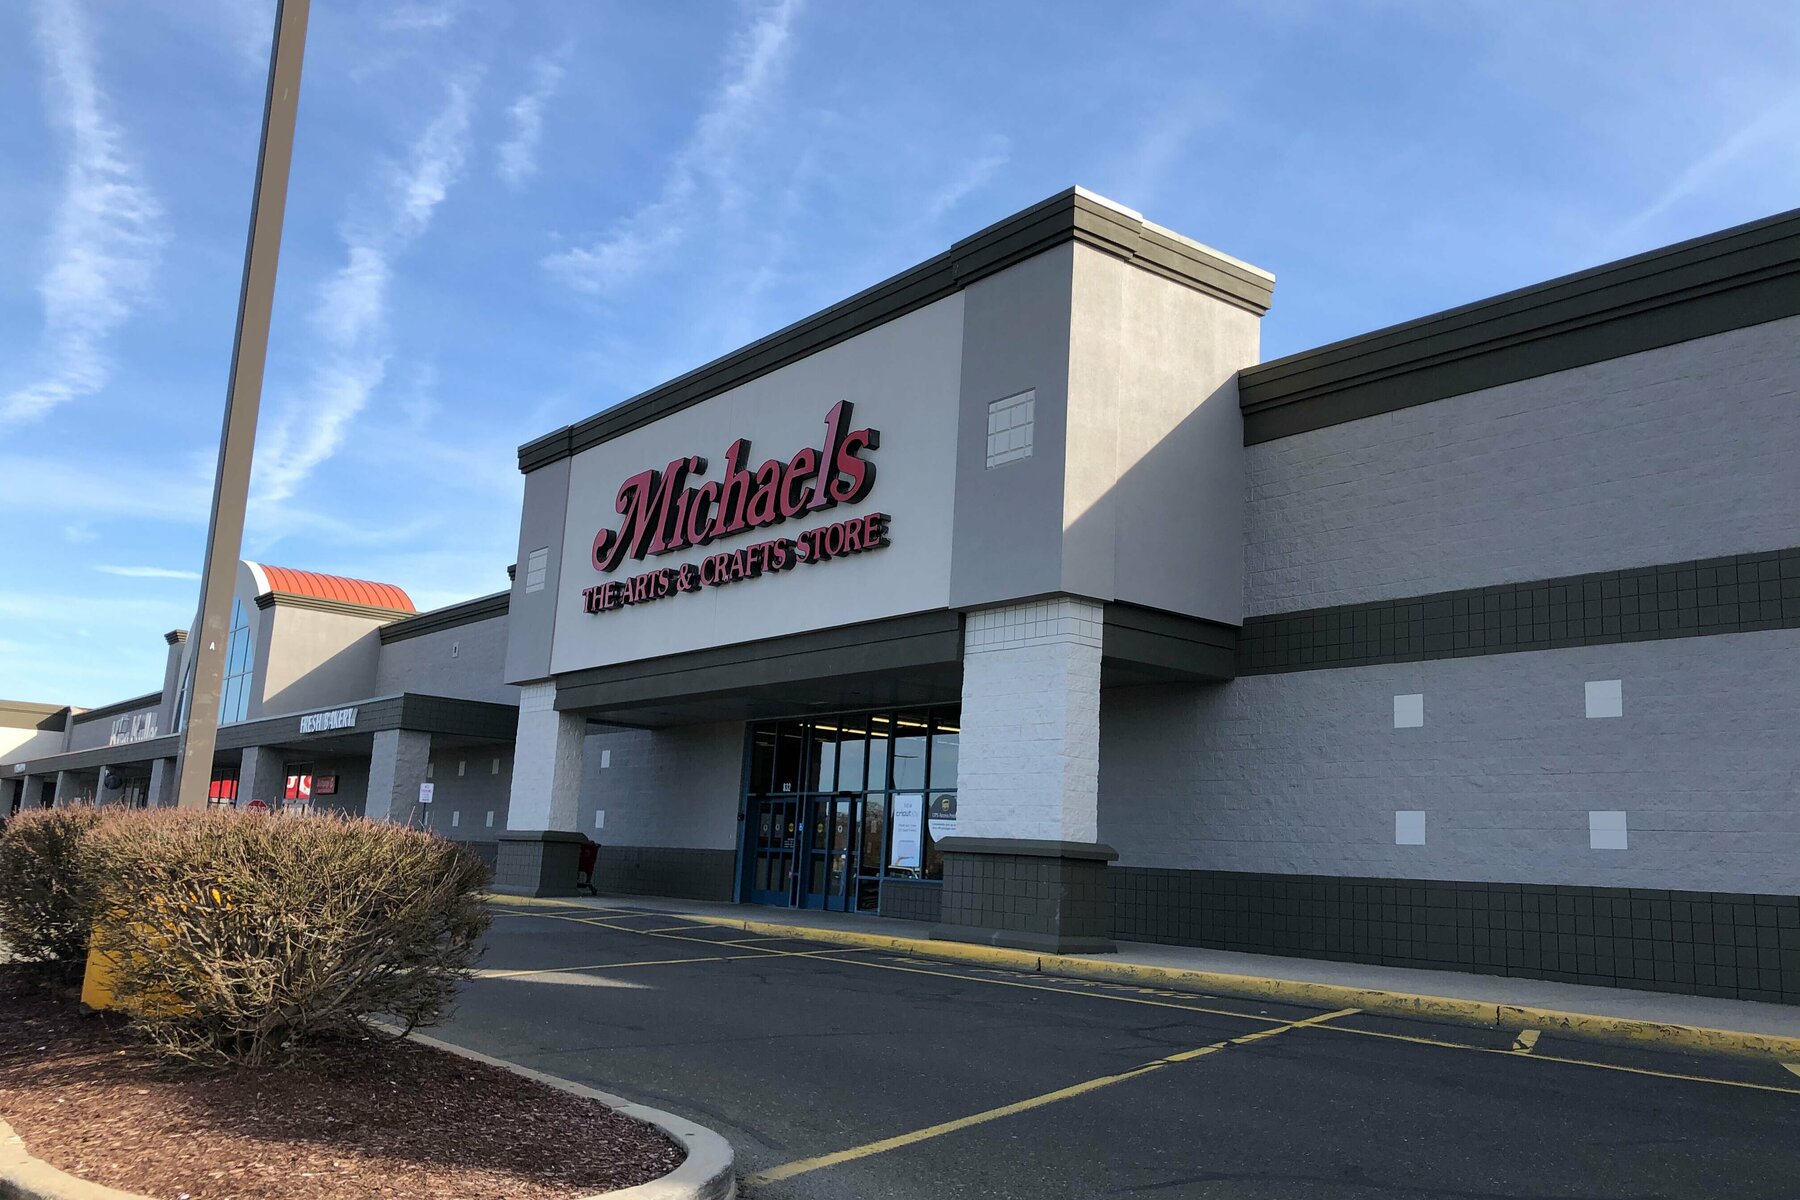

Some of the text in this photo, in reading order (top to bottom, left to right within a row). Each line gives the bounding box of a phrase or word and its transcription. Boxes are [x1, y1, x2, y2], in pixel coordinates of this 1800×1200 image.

[592, 399, 880, 573] Michaels
[582, 512, 891, 614] THE ARTS & CRAFTS STORE
[300, 708, 358, 733] FRESH BAKERY
